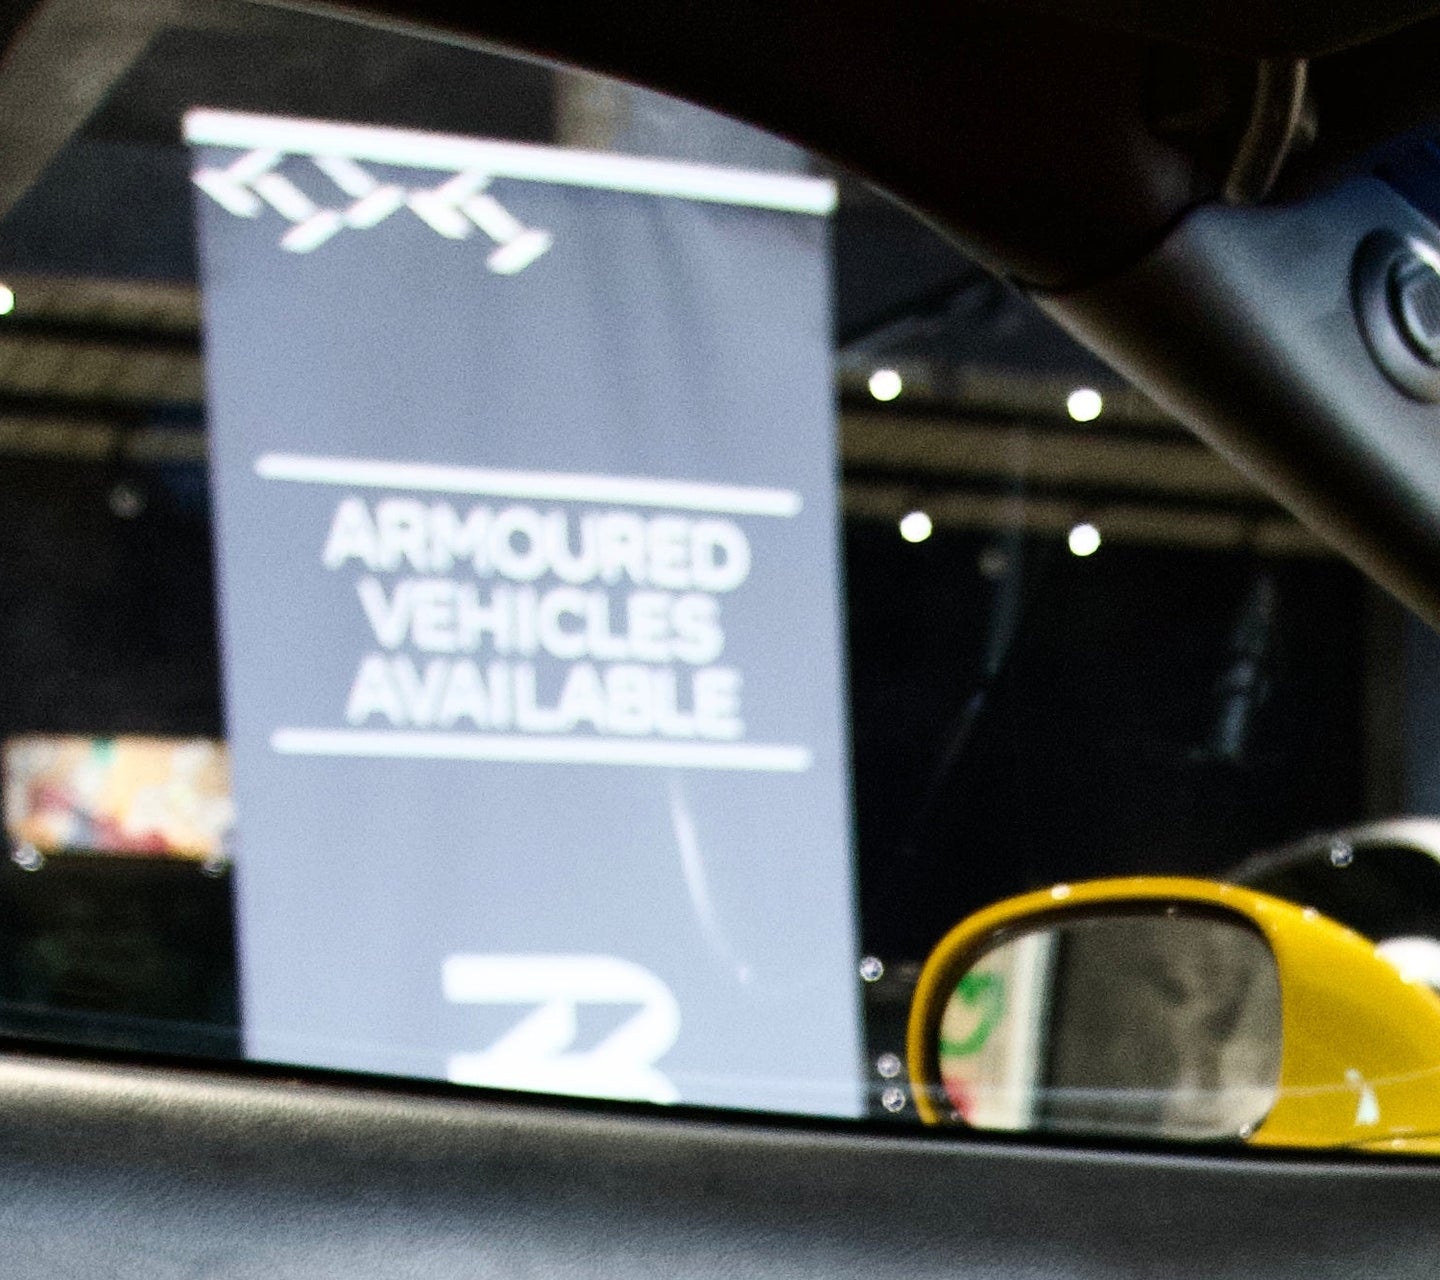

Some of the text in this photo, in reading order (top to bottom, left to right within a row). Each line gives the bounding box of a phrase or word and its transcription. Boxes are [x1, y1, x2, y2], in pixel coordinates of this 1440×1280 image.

[322, 496, 752, 594] ARMOURED
[356, 575, 726, 665] VEHICLES
[344, 652, 746, 741] AVAILABLE
